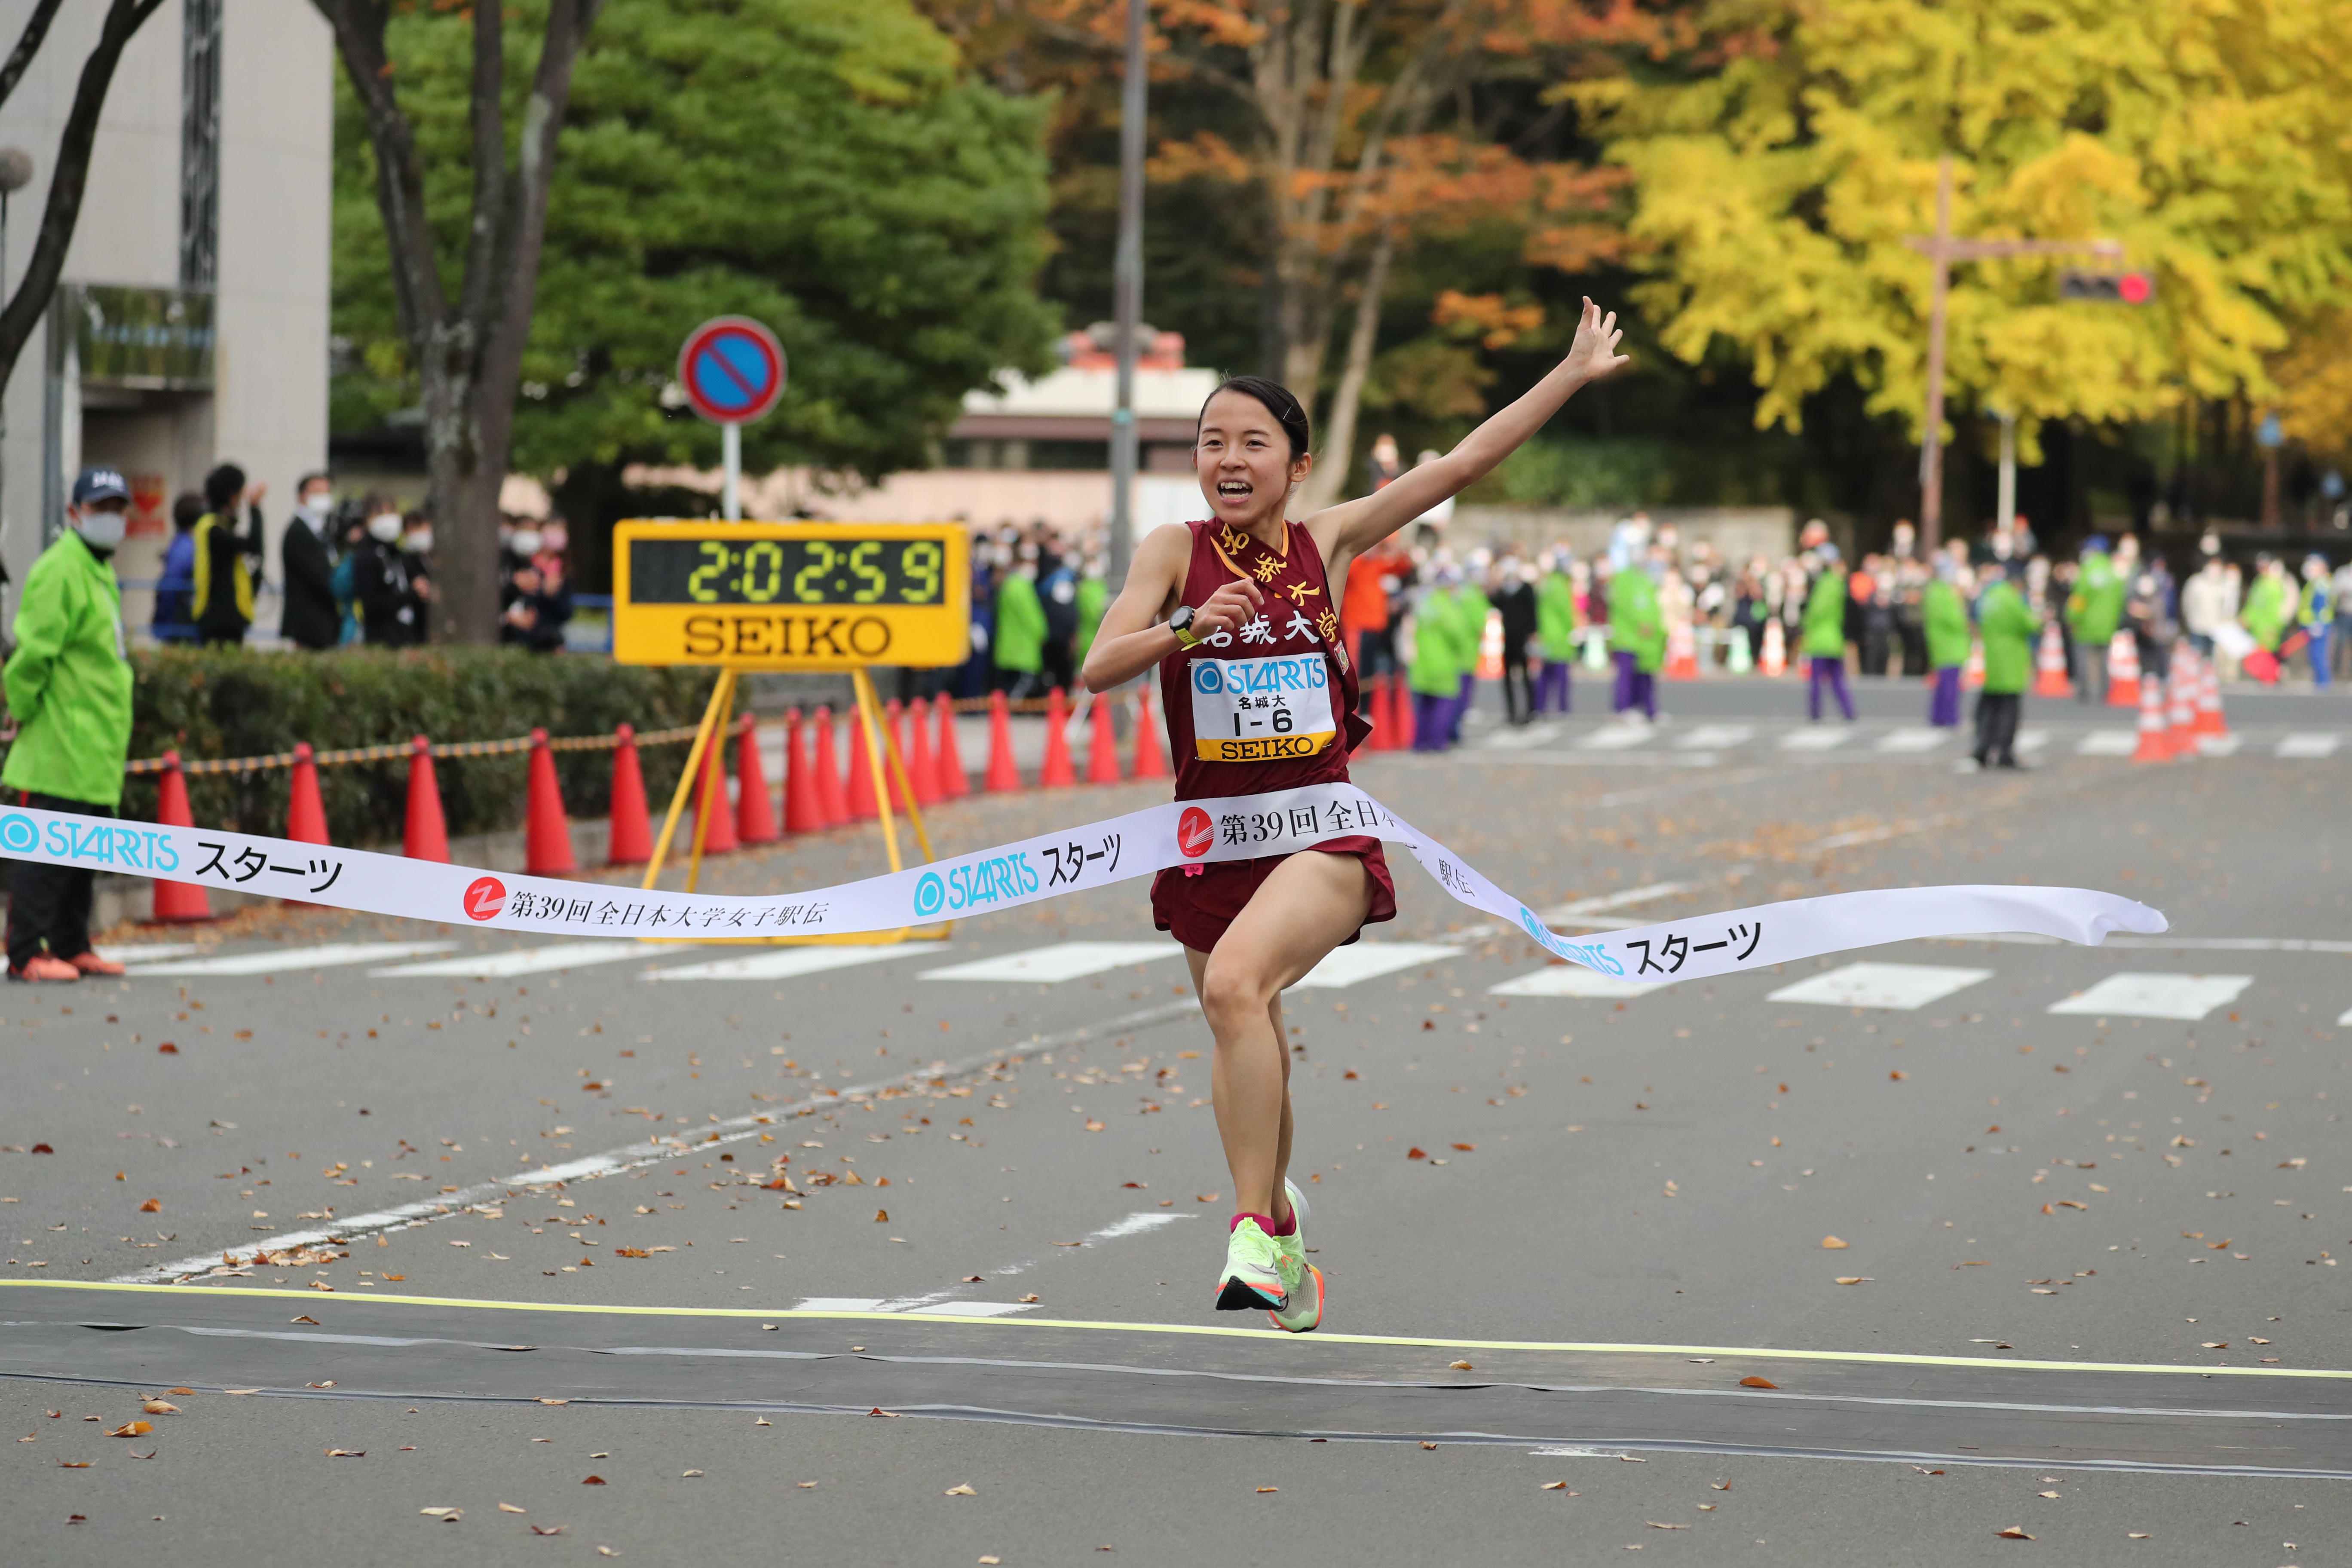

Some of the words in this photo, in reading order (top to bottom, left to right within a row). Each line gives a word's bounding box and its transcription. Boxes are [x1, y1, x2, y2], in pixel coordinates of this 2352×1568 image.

[688, 541, 942, 603] 2:02:59
[1220, 523, 1338, 643] 名城大学
[685, 615, 891, 657] SEIKO
[1227, 658, 1326, 695] STARTS
[1239, 695, 1286, 710] 名城大
[1221, 737, 1314, 760] SEIKO
[45, 821, 179, 872] STARTS
[196, 842, 343, 894] スターツ
[949, 852, 1039, 910] STARTS
[1043, 834, 1121, 887] スターツ
[1438, 858, 1476, 897] 駅伝
[508, 891, 829, 928] 第39回全日本大学女子駅伝
[1626, 922, 1761, 975] スターツ
